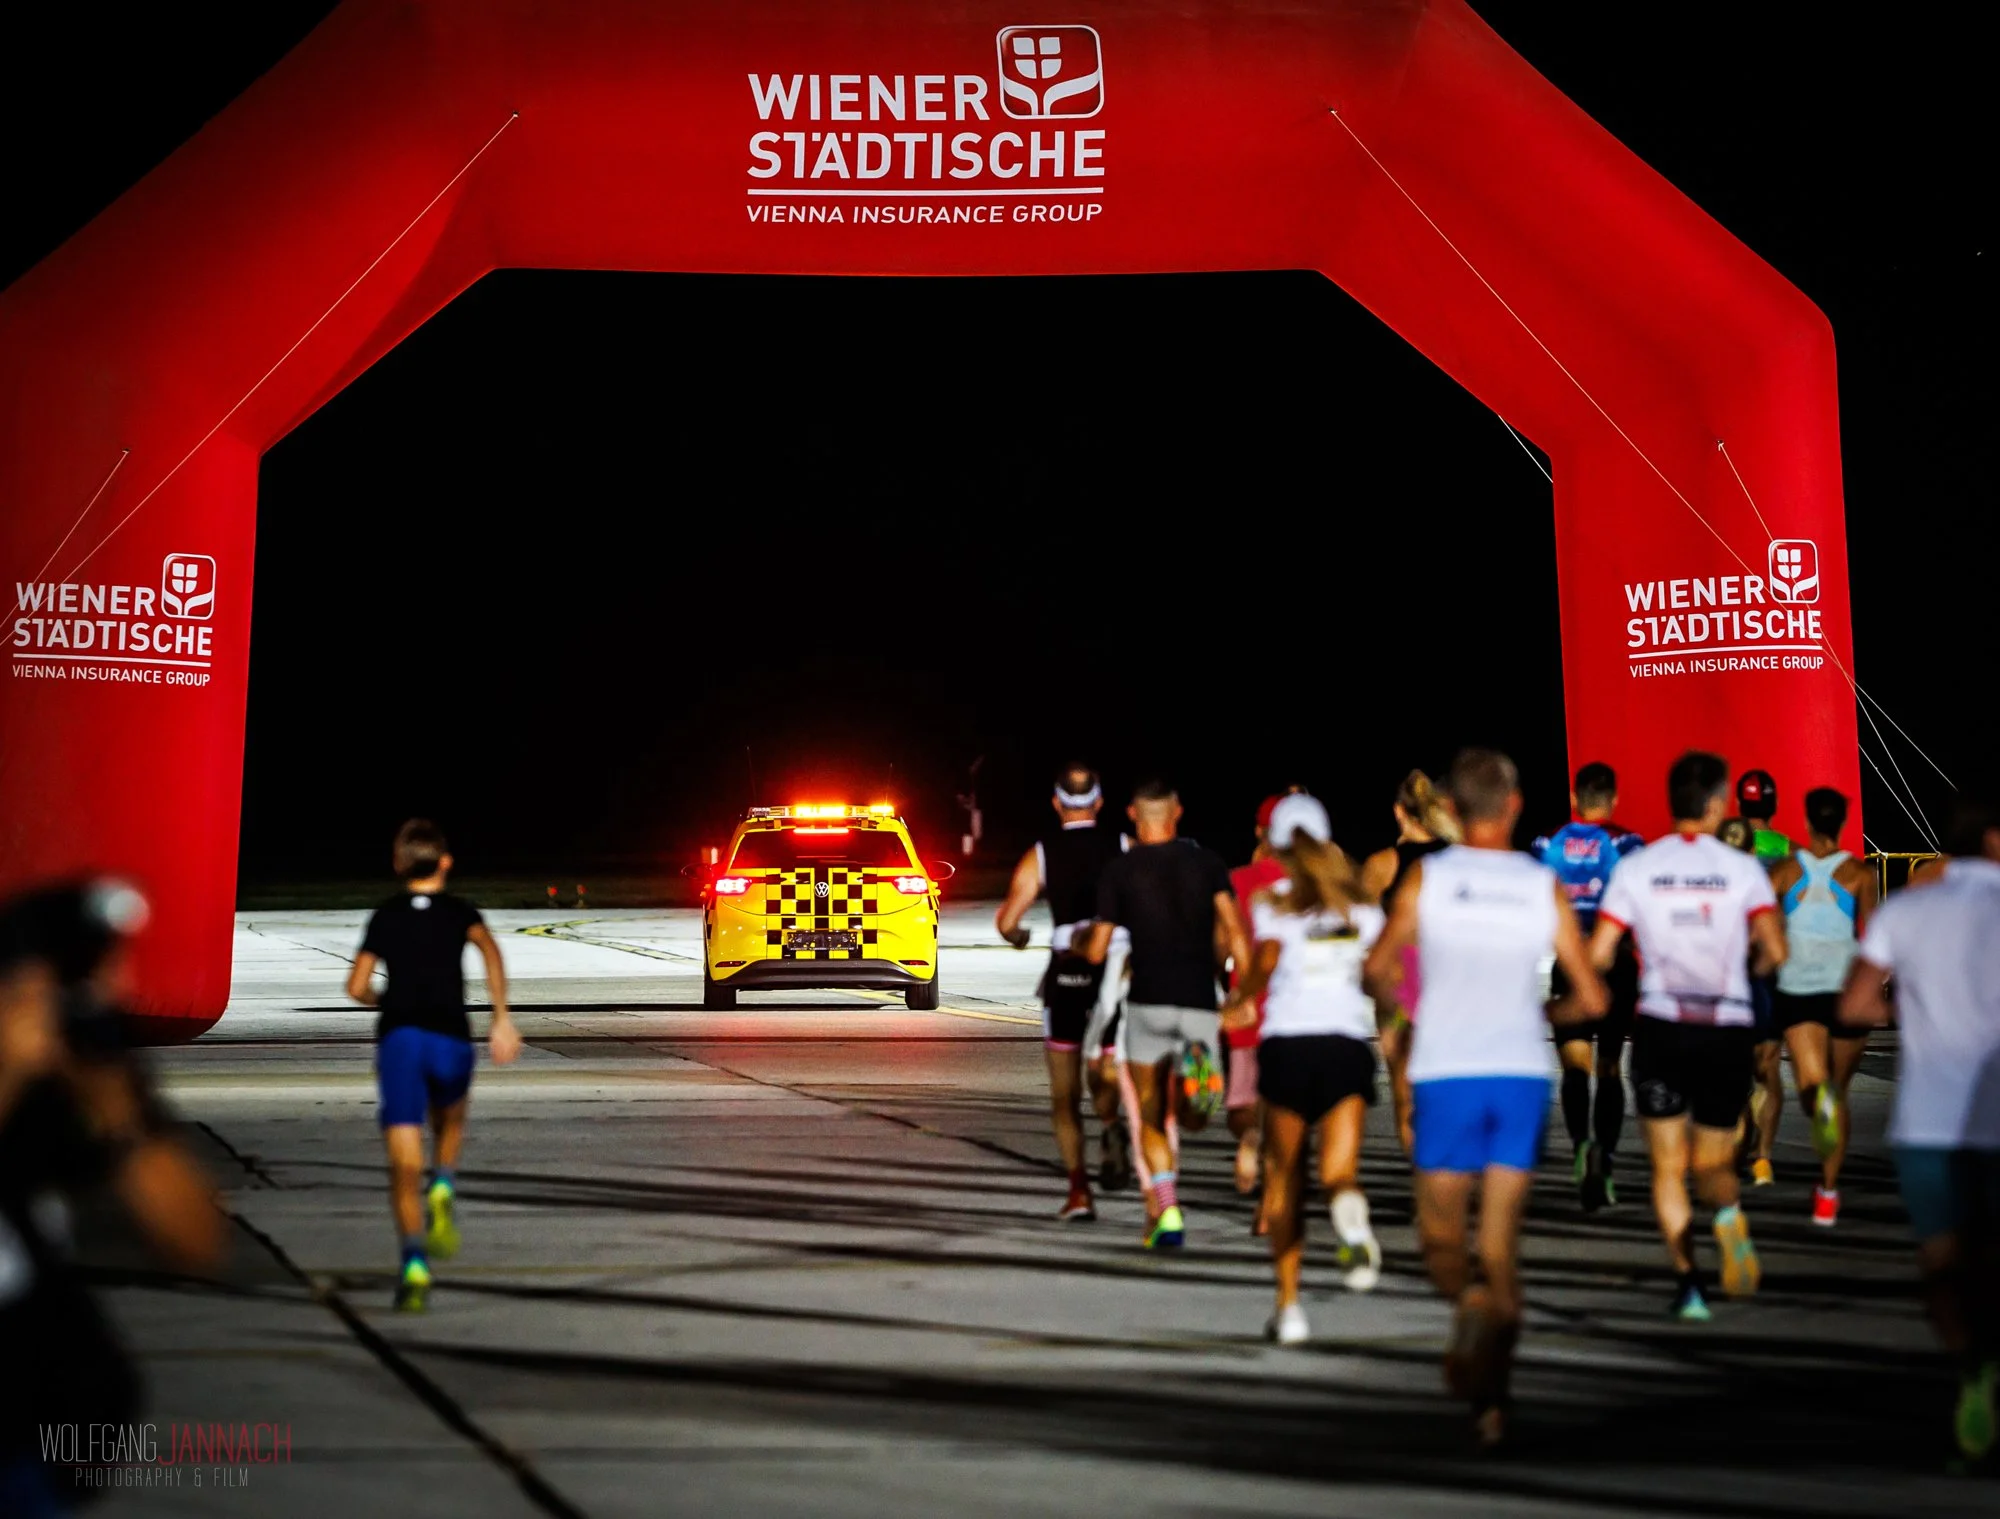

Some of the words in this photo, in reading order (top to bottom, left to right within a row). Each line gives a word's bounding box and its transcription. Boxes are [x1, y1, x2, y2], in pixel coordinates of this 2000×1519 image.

[747, 73, 990, 121] WIENER
[747, 130, 1106, 179] STÄDTISCHE
[747, 205, 845, 223] VIENNA
[853, 205, 1004, 224] INSURANCE
[1012, 204, 1103, 222] GROUP
[16, 582, 155, 617] WIENER
[1625, 575, 1766, 612] WIENER
[13, 618, 213, 656] STÄDTISCHE
[1627, 609, 1822, 647] STÄDTISCHE
[13, 664, 66, 679] VIENNA
[71, 666, 161, 683] INSURANCE
[166, 672, 210, 686] GROUP
[1630, 661, 1686, 678] VIENNA
[1690, 656, 1778, 673] INSURANCE
[1783, 656, 1824, 670] GROUP
